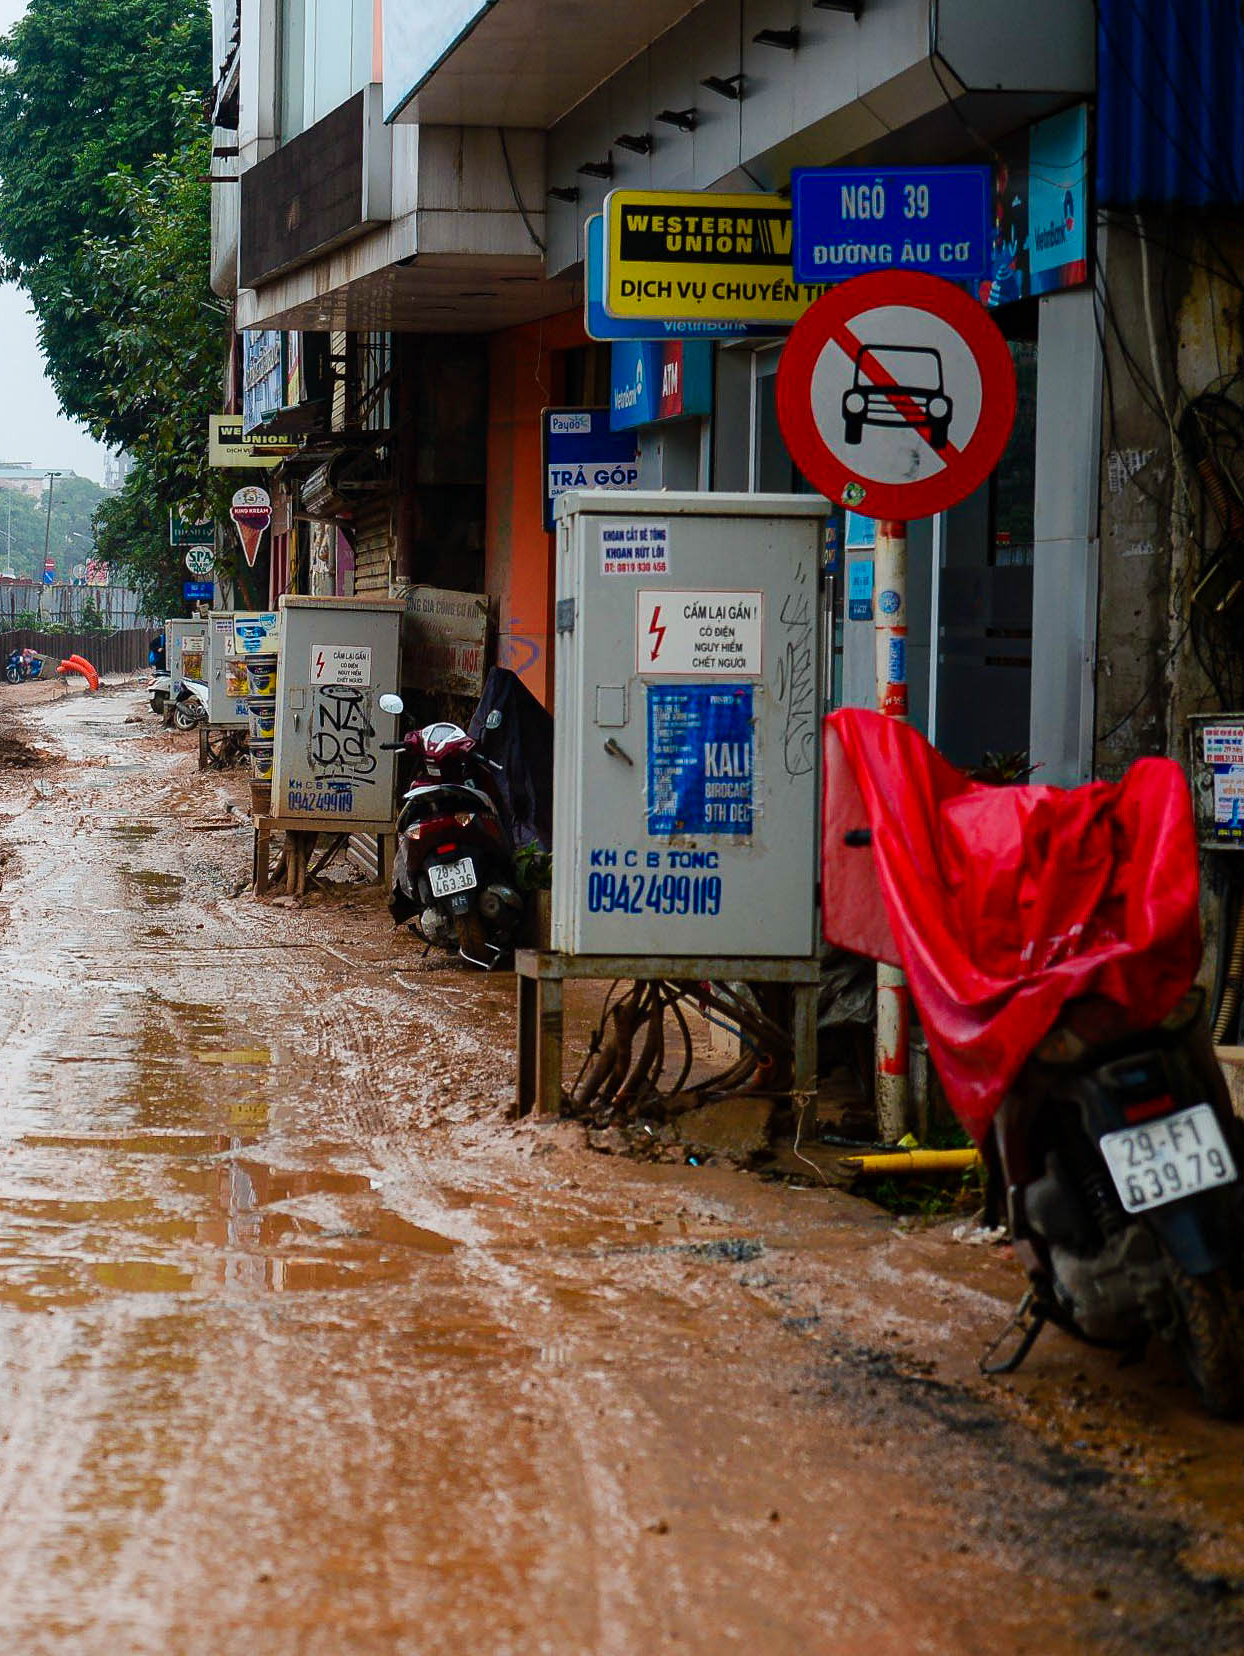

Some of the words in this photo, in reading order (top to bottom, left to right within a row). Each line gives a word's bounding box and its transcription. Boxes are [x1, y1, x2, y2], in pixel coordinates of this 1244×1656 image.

[841, 178, 885, 220] NGÕ
[903, 184, 929, 220] 39
[626, 215, 753, 235] WESTERN
[665, 235, 753, 254] UNION
[813, 239, 892, 265] ĐƯỜNG
[900, 239, 931, 263] ÂU
[939, 241, 971, 262] CƠ
[620, 280, 672, 302] DỊCH
[677, 281, 706, 304] VỤ
[712, 278, 799, 302] CHUYỂN
[662, 361, 678, 397] ATM
[552, 418, 581, 432] Payoo
[242, 435, 289, 444] UNION
[551, 465, 587, 486] TRẢ
[594, 465, 638, 486] GÓP
[189, 551, 212, 562] SPA
[683, 600, 707, 619] CẤM
[708, 605, 726, 622] LẠI
[694, 643, 718, 652] NGUY
[704, 742, 750, 777] KALI
[288, 791, 353, 812] 0942499119
[705, 803, 726, 822] 9TH
[729, 803, 750, 822] DEC
[590, 849, 617, 867] KH
[624, 850, 638, 867] C
[646, 851, 660, 868] B
[588, 871, 722, 916] 0942499119
[1122, 1115, 1203, 1167] 29-F1
[1125, 1148, 1228, 1207] 639.79
